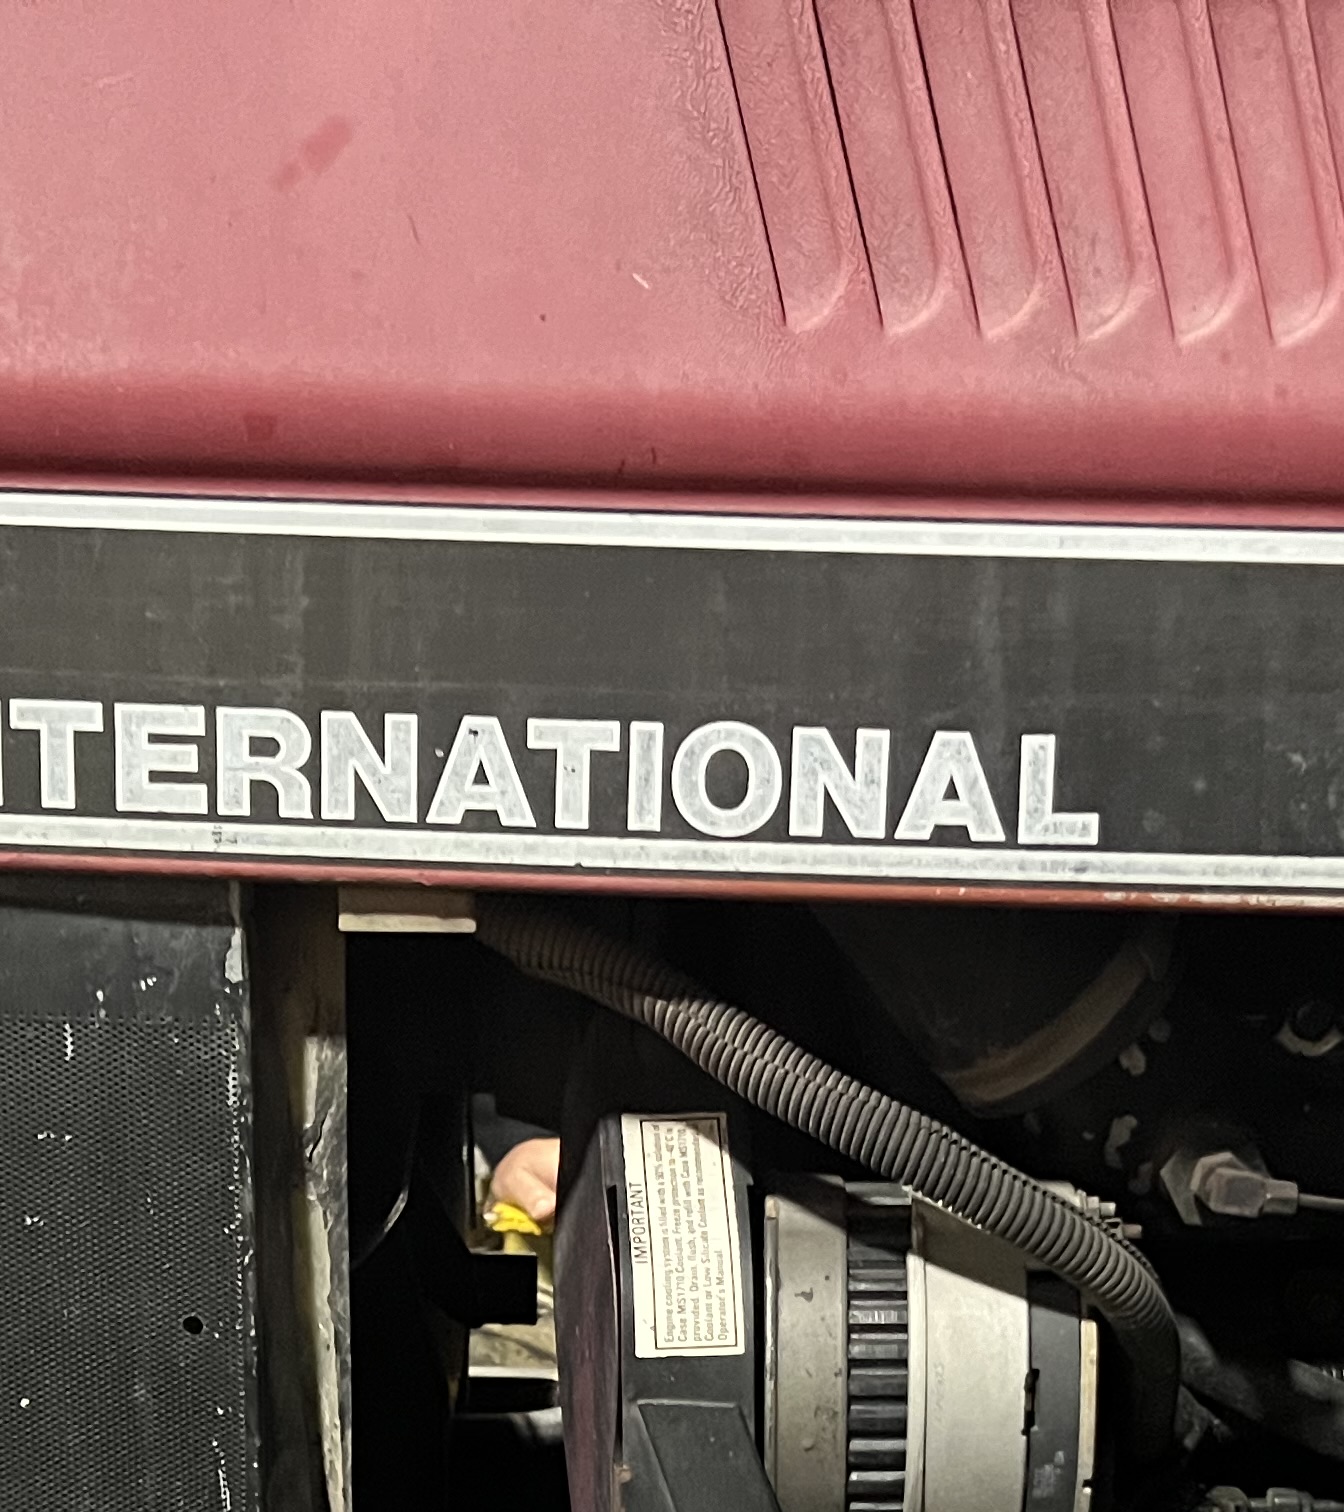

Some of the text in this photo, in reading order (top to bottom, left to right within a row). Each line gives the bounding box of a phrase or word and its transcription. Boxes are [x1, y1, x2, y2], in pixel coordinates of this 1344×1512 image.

[629, 1182, 648, 1264] IMPORTANT
[672, 1209, 681, 1234] Freeze
[663, 1270, 673, 1306] cooling
[703, 1267, 711, 1287] Low
[676, 1276, 686, 1314] MS1710
[705, 1290, 712, 1300] or
[664, 1309, 676, 1342] Engine
[678, 1318, 687, 1342] Case
[704, 1303, 714, 1341] Coolant
